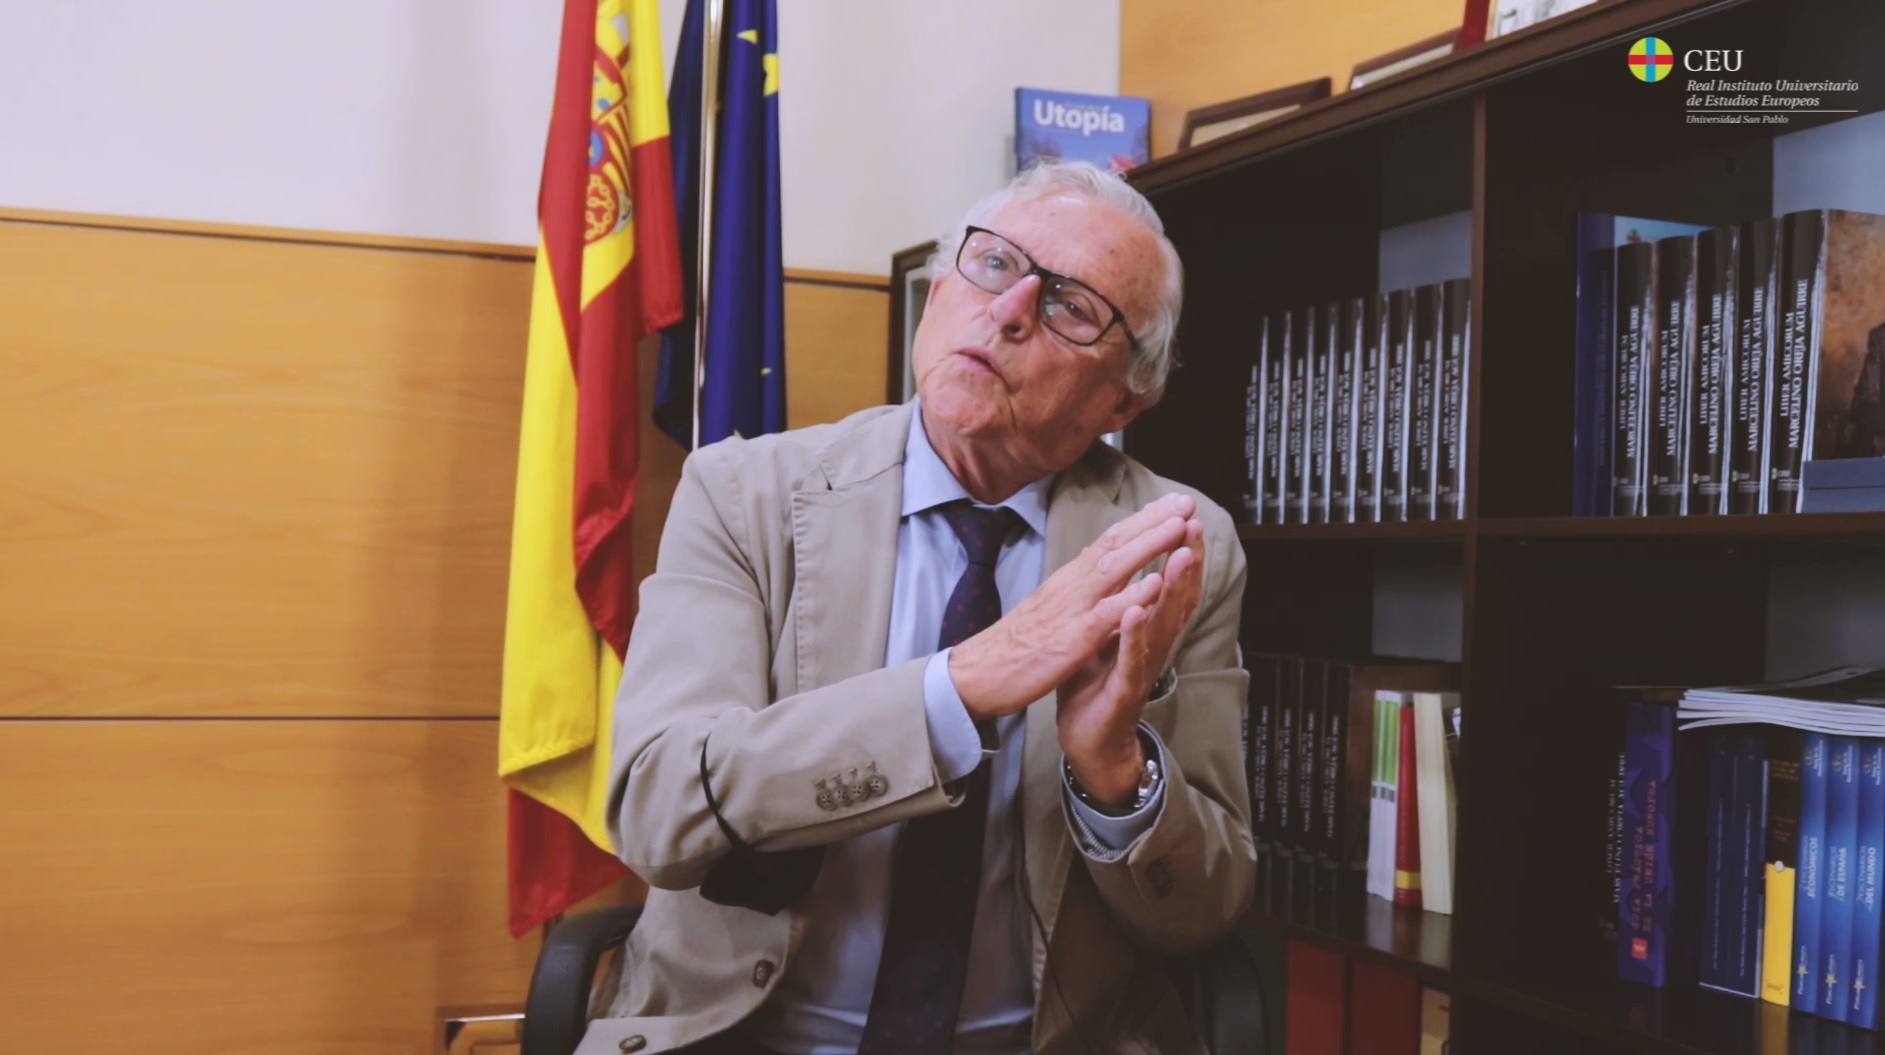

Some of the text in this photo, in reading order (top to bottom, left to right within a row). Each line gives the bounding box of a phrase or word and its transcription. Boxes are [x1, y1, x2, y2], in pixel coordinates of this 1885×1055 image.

[1034, 99, 1125, 136] Utopía
[1627, 305, 1639, 457] MARCELINO OREJA AGUIRRE
[1667, 300, 1680, 456] MARCELINO OREJA AGUIRRE
[1708, 294, 1722, 454] MARCELINO OREJA AGUIRRE
[1748, 287, 1763, 451] MARCELINO OREJA AGUIRRE
[1780, 312, 1793, 416] LIBER AMICORUM
[1789, 279, 1808, 448] MARCELINO OREJA AGUIRRE
[1837, 884, 1845, 896] DE
[1865, 847, 1875, 904] DEL MUNDO
